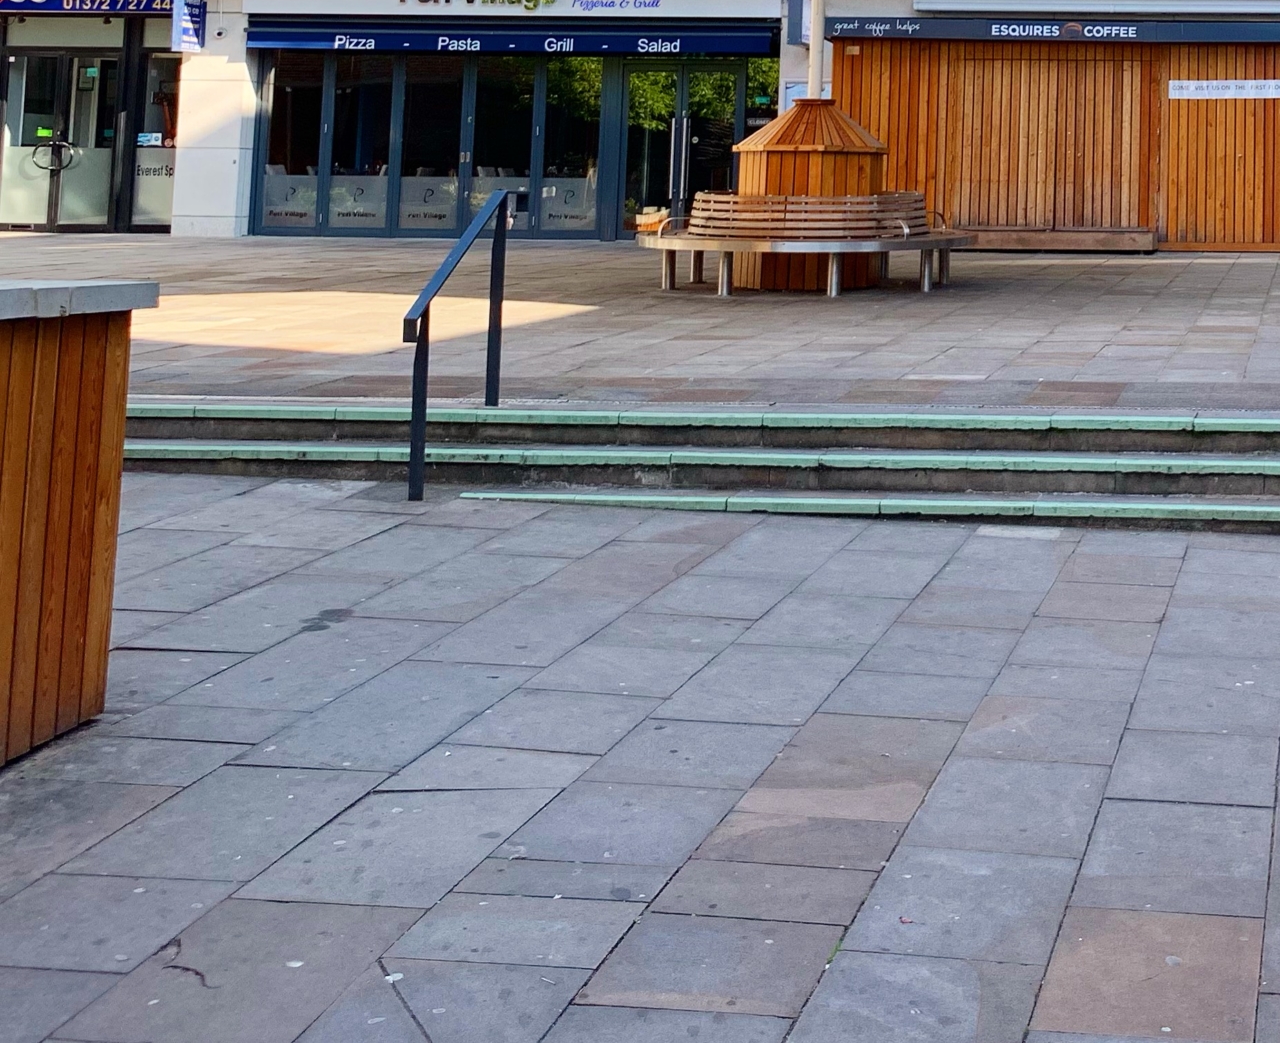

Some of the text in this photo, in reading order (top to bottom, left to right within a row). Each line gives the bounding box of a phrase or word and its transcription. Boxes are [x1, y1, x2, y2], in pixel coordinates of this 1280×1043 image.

[834, 19, 920, 36] great coffee helps
[991, 24, 1137, 38] ESQUIRES COFFEE
[334, 35, 375, 49] Pizza
[437, 37, 480, 51] Pasta
[544, 38, 574, 52] Grill
[637, 39, 680, 53] Salad
[137, 165, 164, 176] Everest
